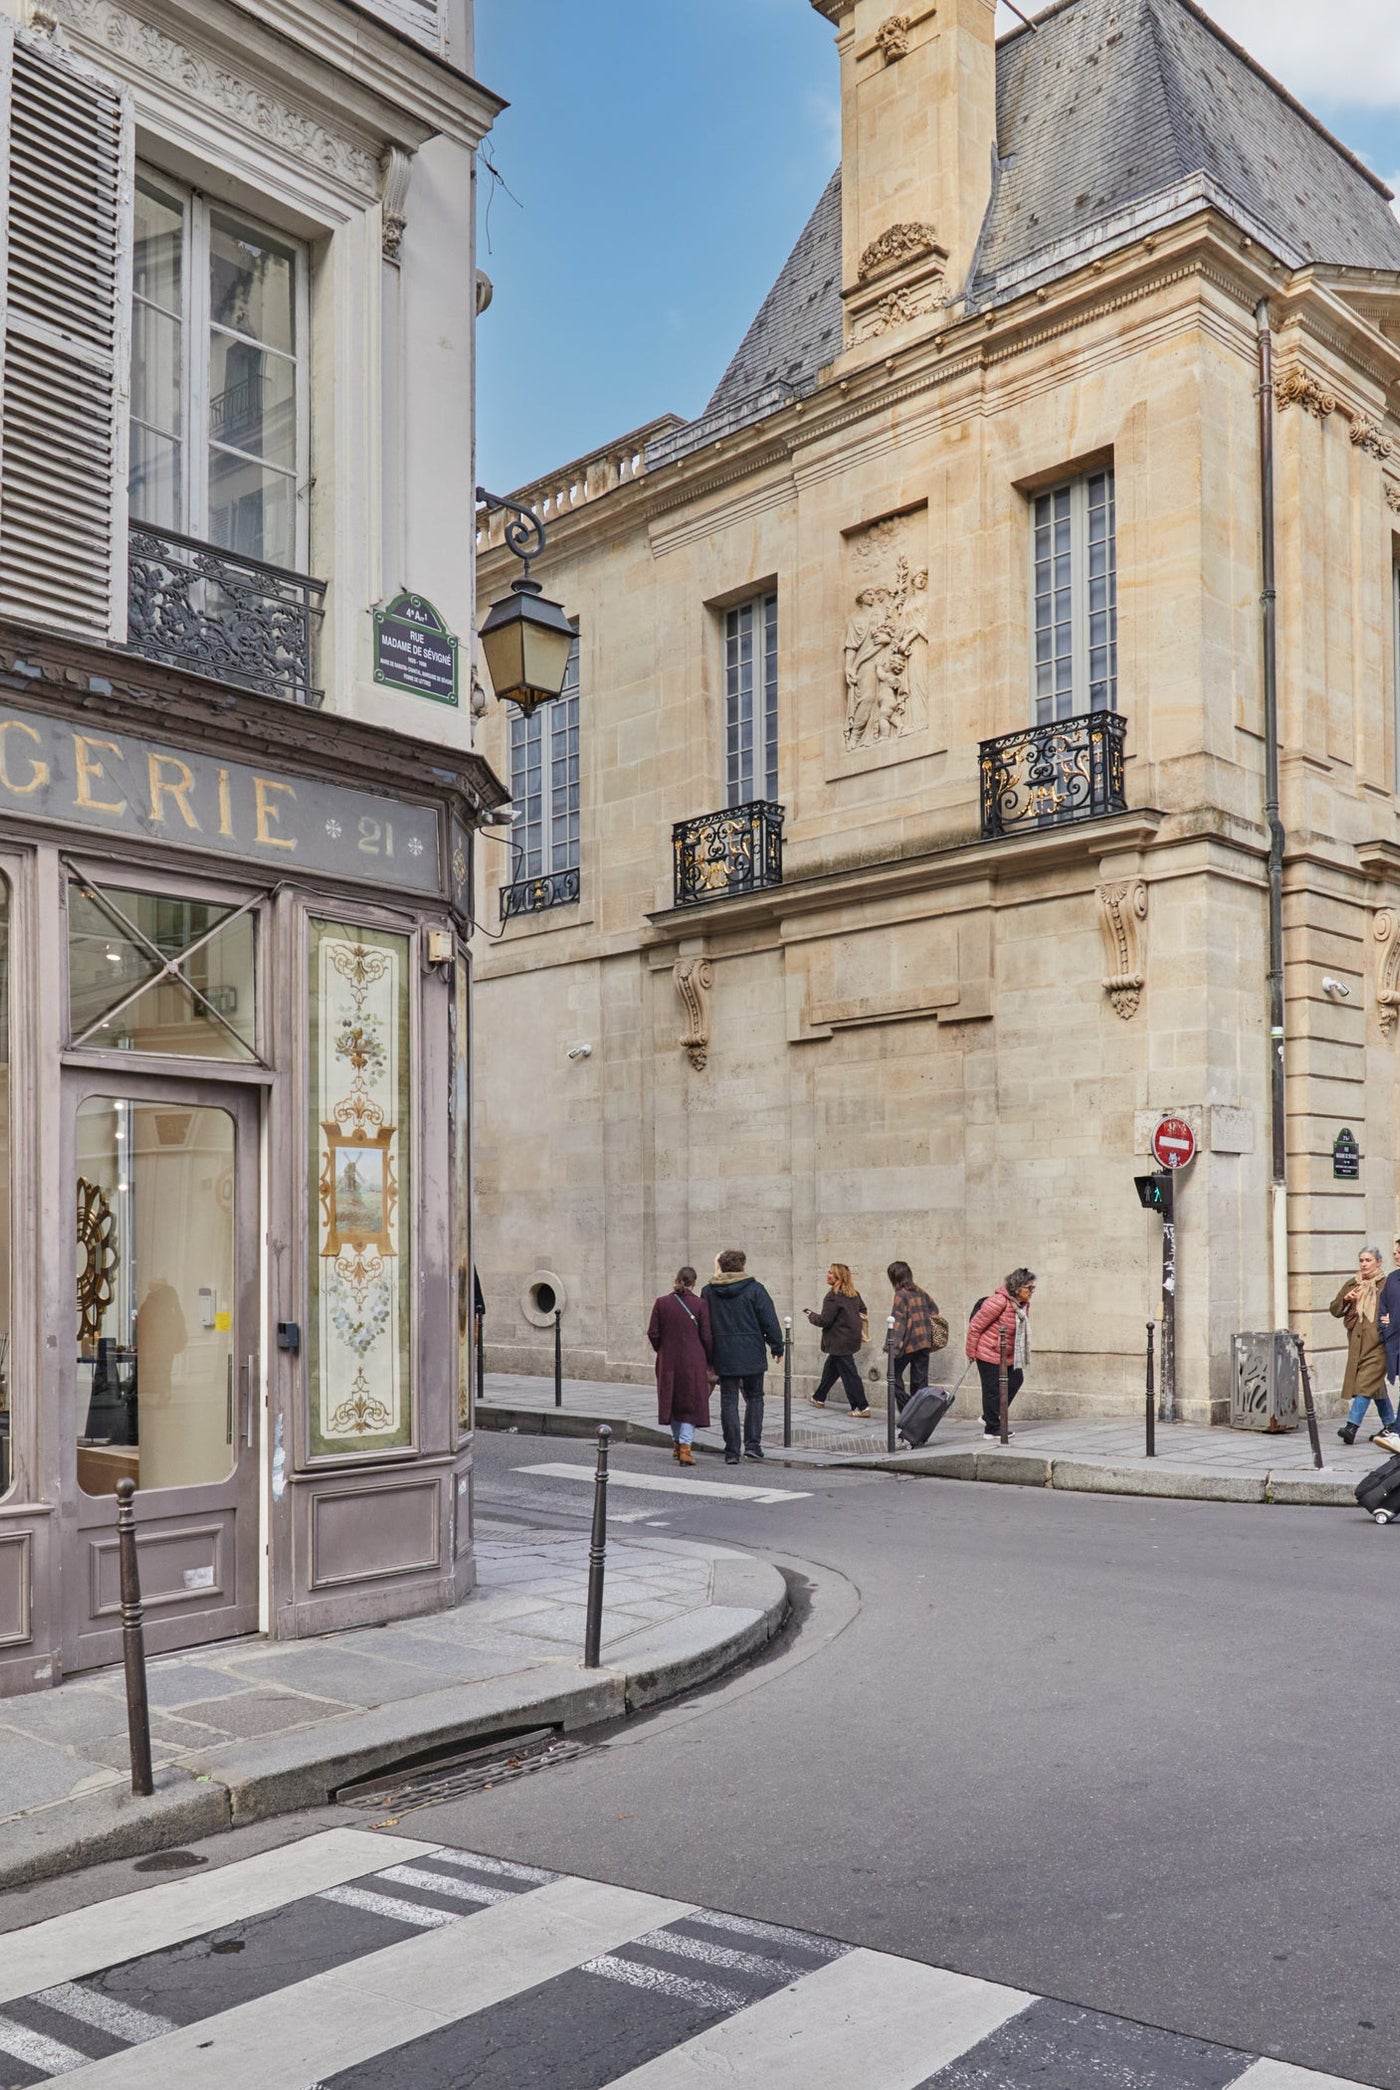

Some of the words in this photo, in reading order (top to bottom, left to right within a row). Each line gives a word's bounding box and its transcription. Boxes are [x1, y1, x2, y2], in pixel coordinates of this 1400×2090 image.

[381, 634, 412, 653] MADAME
[412, 644, 422, 656] DE
[423, 647, 452, 666] SÉVIGNÉ
[410, 630, 425, 644] RUE
[0, 720, 298, 851] GERIE
[358, 816, 394, 858] 21
